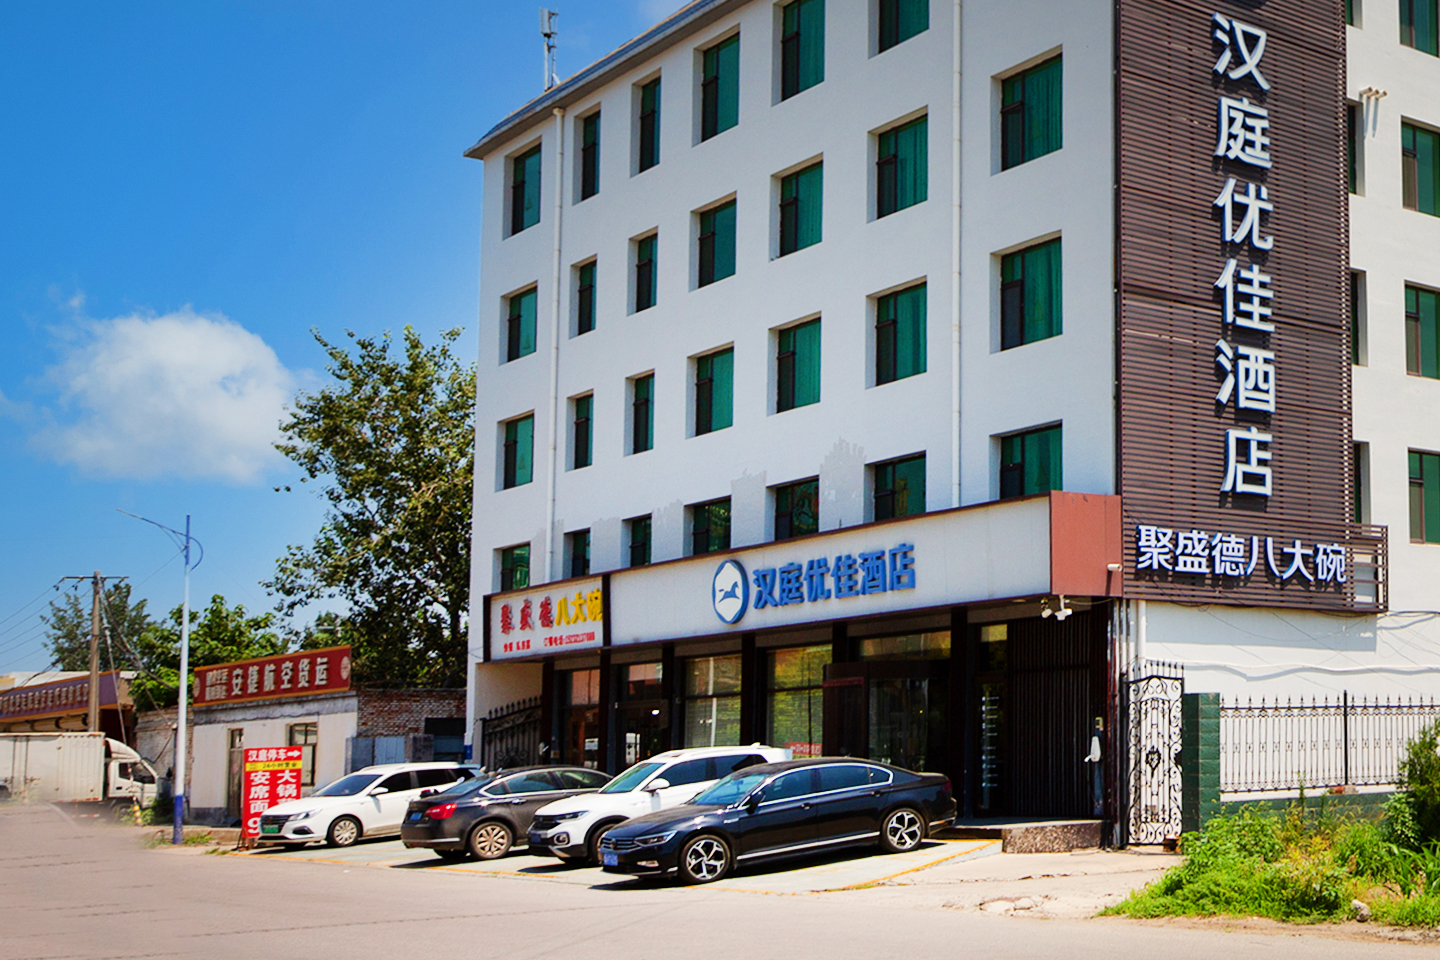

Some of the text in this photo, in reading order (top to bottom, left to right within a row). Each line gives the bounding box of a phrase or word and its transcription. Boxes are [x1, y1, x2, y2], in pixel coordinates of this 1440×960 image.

[1211, 11, 1276, 497] 汉庭优佳酒店
[753, 543, 916, 609] 汉庭优佳酒店
[1136, 524, 1348, 583] 聚盛德八大碗
[231, 657, 329, 696] 安捷航空货运
[247, 748, 288, 762] 汉庭停车
